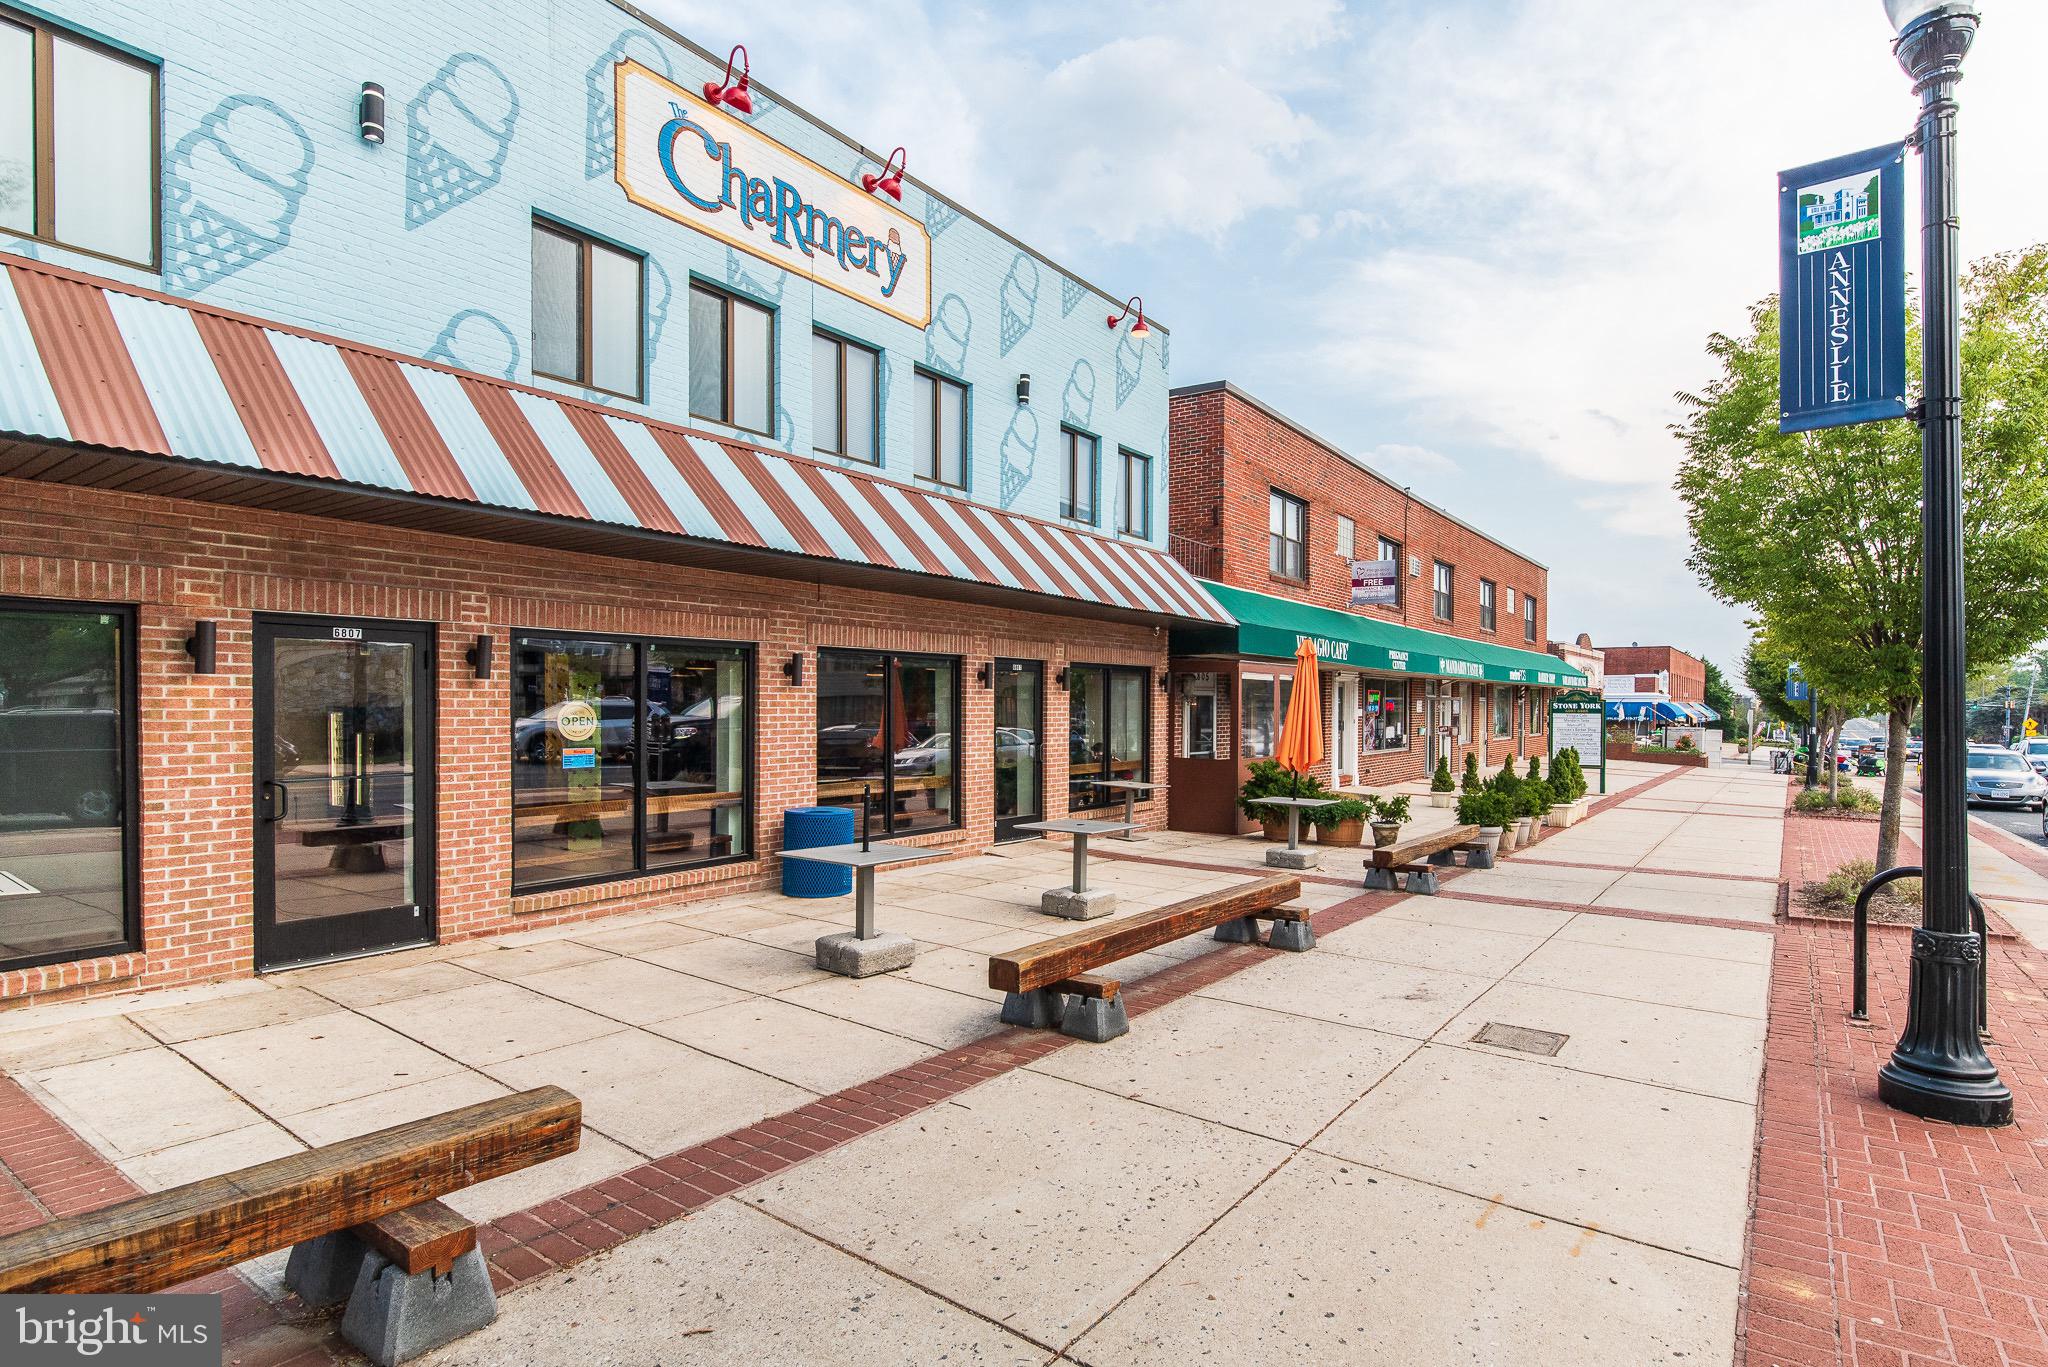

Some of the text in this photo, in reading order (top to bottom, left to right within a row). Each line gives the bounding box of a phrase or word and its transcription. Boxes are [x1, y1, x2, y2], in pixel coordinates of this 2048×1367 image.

[668, 101, 688, 119] The
[1829, 251, 1850, 403] ANNESLIE
[1363, 579, 1384, 587] FREE
[334, 628, 361, 638] 6807
[561, 716, 593, 726] OPEN
